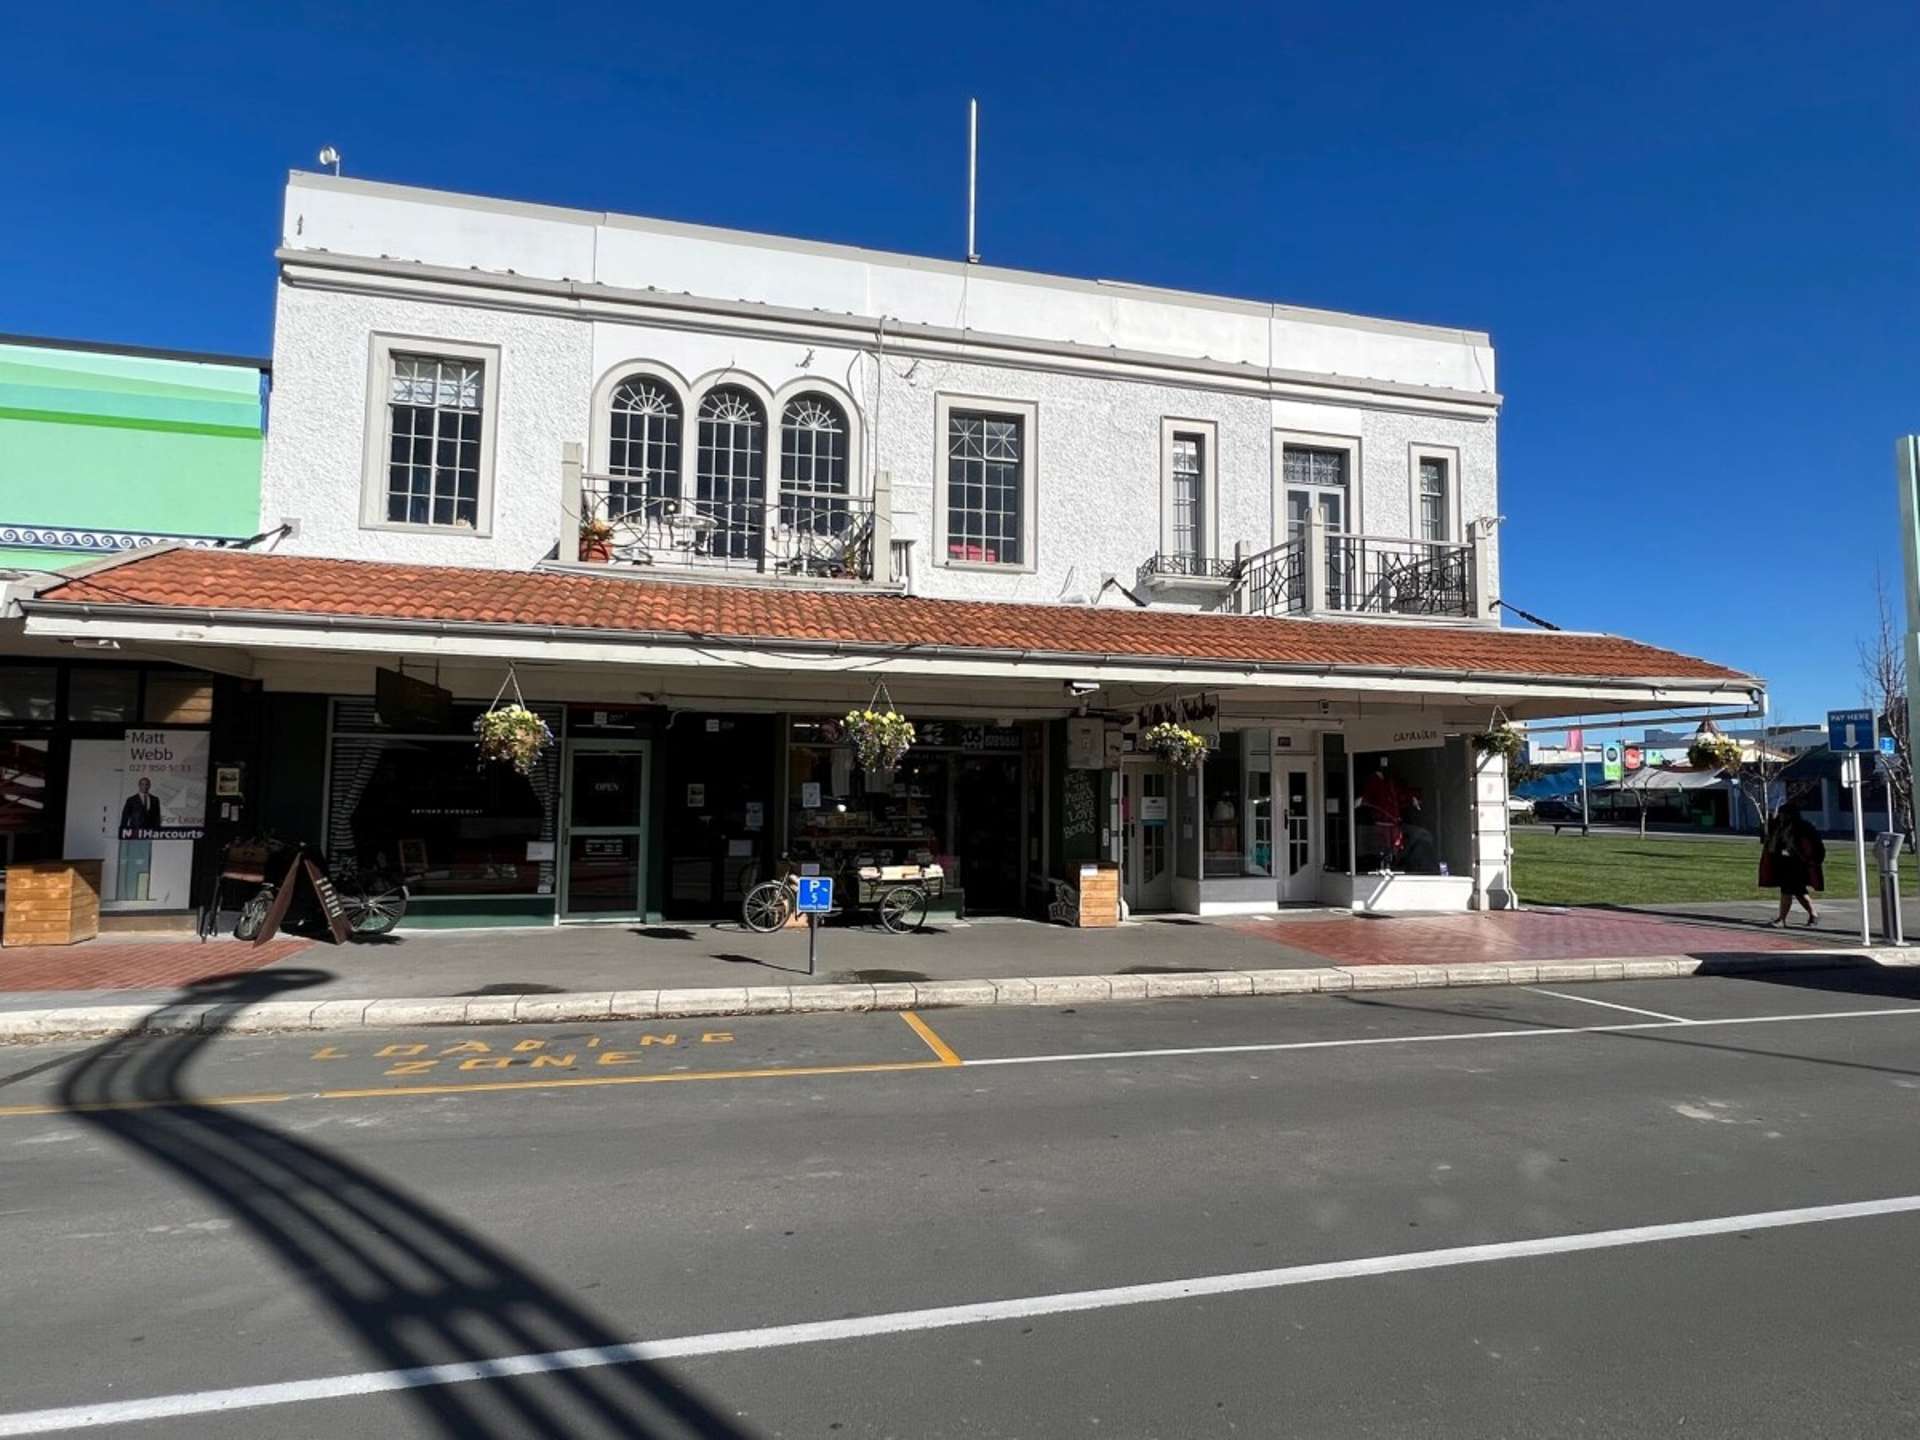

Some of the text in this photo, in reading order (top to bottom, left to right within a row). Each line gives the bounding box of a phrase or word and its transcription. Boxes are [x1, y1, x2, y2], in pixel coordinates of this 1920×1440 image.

[1831, 712, 1870, 721] PAY HERE
[131, 732, 165, 744] Matt
[130, 748, 174, 760] Webb
[595, 782, 619, 791] OPEN
[143, 829, 205, 839] Harcourts
[1064, 820, 1096, 838] BOOKS
[810, 880, 820, 893] P
[310, 1032, 734, 1060] LOADING
[383, 1051, 642, 1075] ZONE
